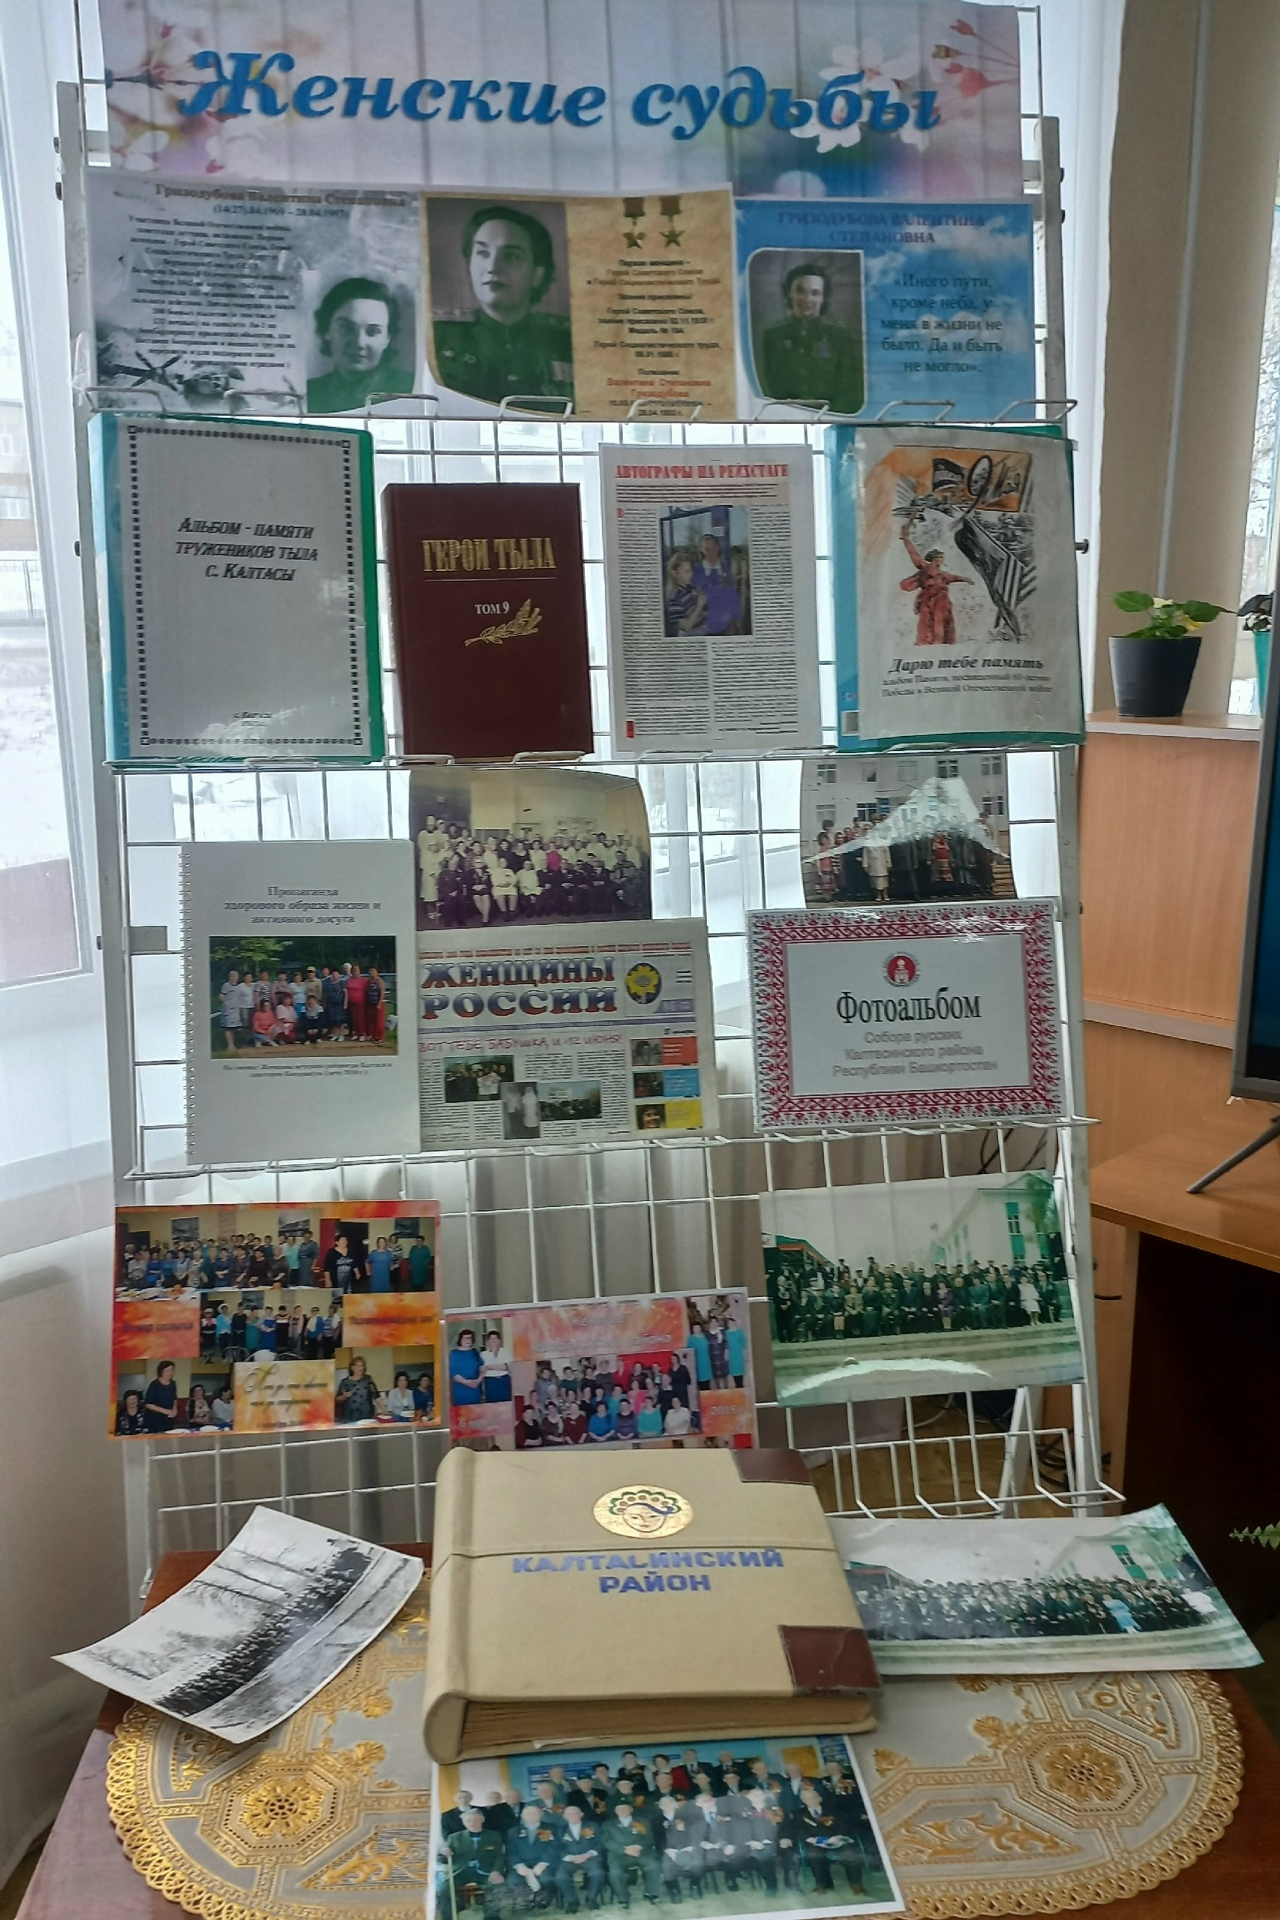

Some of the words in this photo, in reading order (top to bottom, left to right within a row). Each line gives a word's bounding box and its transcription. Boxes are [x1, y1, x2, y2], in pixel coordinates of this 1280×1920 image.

[182, 50, 606, 127] Женские
[630, 66, 940, 141] судьбы
[829, 227, 935, 243] СТЕПАНОВНА
[953, 276, 992, 290] пути,
[891, 298, 936, 311] кроме
[940, 296, 978, 311] неба,
[982, 299, 993, 312] у
[880, 319, 917, 331] меня
[921, 320, 930, 330] в
[934, 319, 982, 331] жизни
[986, 320, 1003, 331] не
[880, 338, 924, 351] было.
[928, 338, 949, 354] Да
[953, 341, 962, 351] и
[965, 338, 1004, 352] быть
[904, 361, 921, 372] не
[615, 465, 693, 479] АВТОГРАФЫ
[697, 465, 715, 478] НА
[422, 538, 491, 571] ГЕРОИ
[493, 537, 557, 570] ТЫЛА
[502, 601, 510, 614] 9
[888, 658, 934, 674] Дарю
[938, 656, 978, 669] тебе
[981, 657, 1044, 670] память
[267, 886, 339, 897] Пропаганда
[224, 901, 286, 912] здорового
[288, 900, 329, 912] образа
[332, 901, 370, 910] жизни
[373, 902, 381, 910] и
[251, 915, 314, 924] активного
[421, 956, 615, 989] ЖЕНЩИНЫ
[420, 987, 618, 1020] РОССИИ
[836, 986, 982, 1024] Фотоальбом
[512, 1547, 784, 1574] КАЛТАСИНСКИЙ
[599, 1571, 711, 1594] РАЙОН
